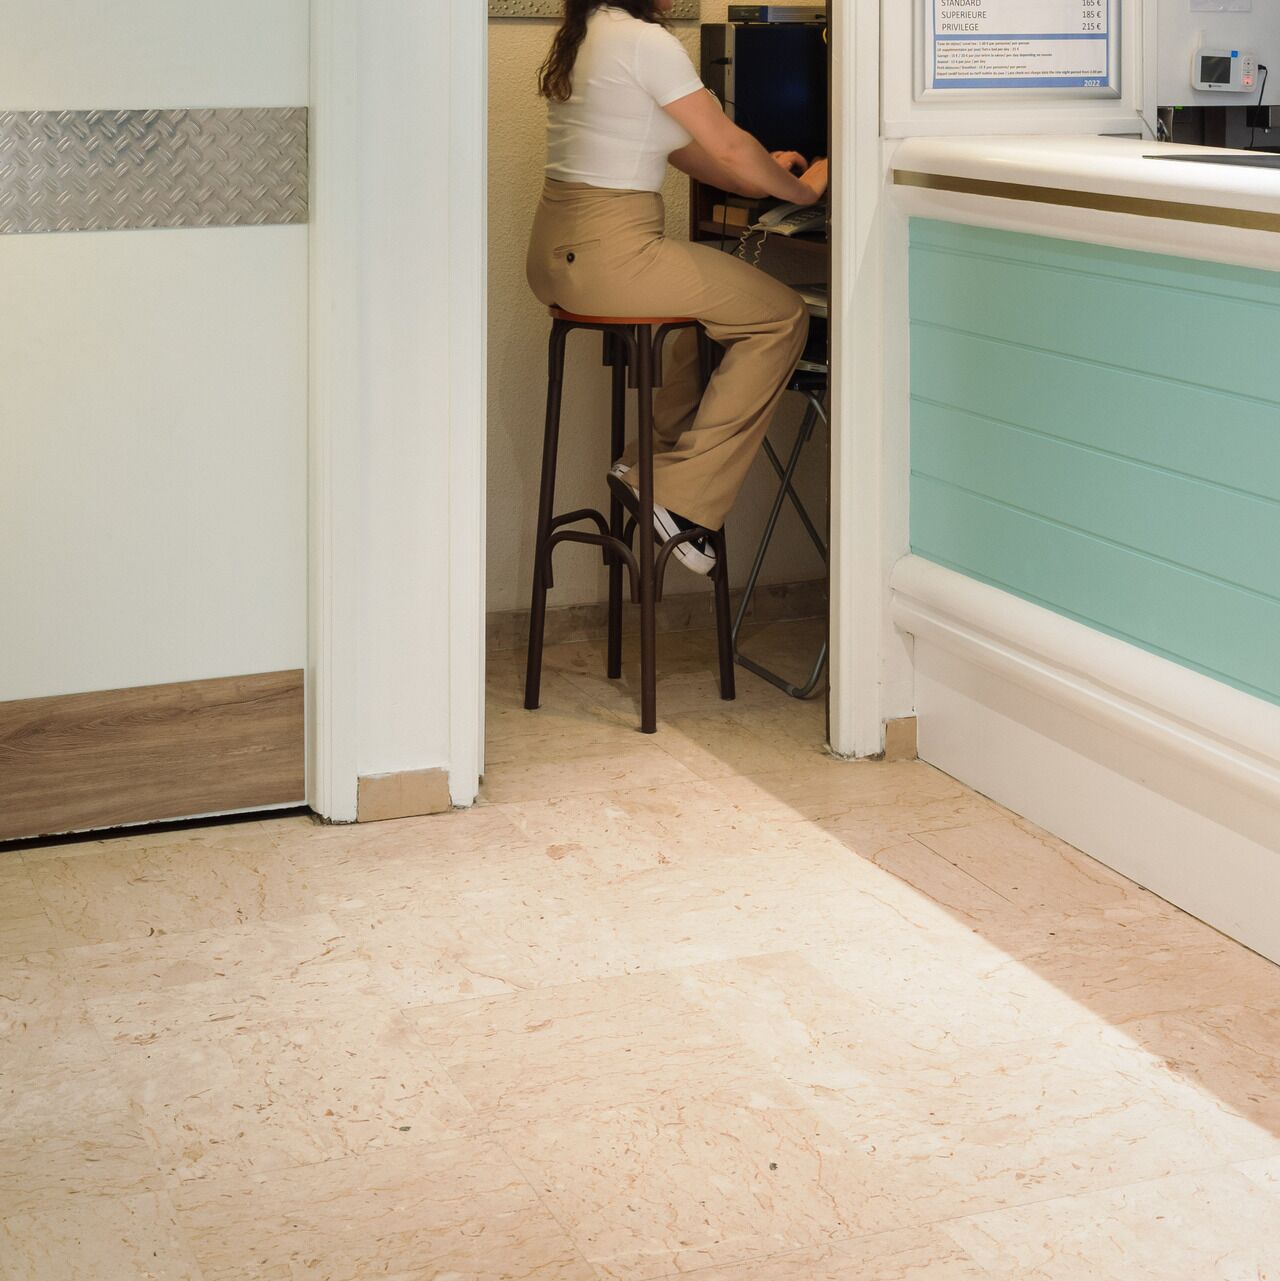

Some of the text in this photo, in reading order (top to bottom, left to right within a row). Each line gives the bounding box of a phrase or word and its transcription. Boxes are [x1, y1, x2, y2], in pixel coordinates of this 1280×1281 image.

[941, 10, 987, 19] SUPERIEURE
[1082, 10, 1095, 19] 185
[941, 23, 979, 31] PRIVILEGE
[1082, 22, 1095, 31] 215
[1084, 79, 1101, 87] 2022
